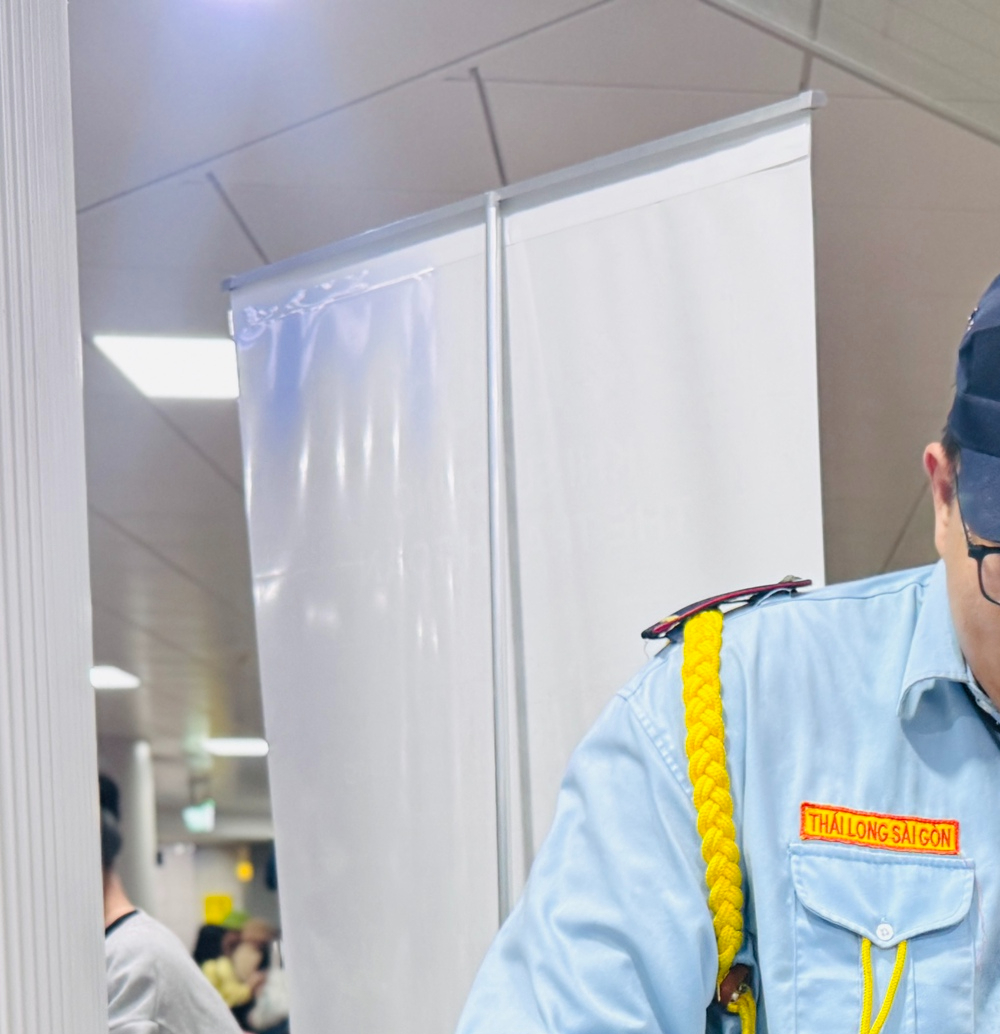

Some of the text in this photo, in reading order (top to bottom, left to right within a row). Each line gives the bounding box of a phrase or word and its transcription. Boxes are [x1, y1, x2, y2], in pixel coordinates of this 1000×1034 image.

[808, 812, 951, 847] THÁI LONG SÀI GÒN
